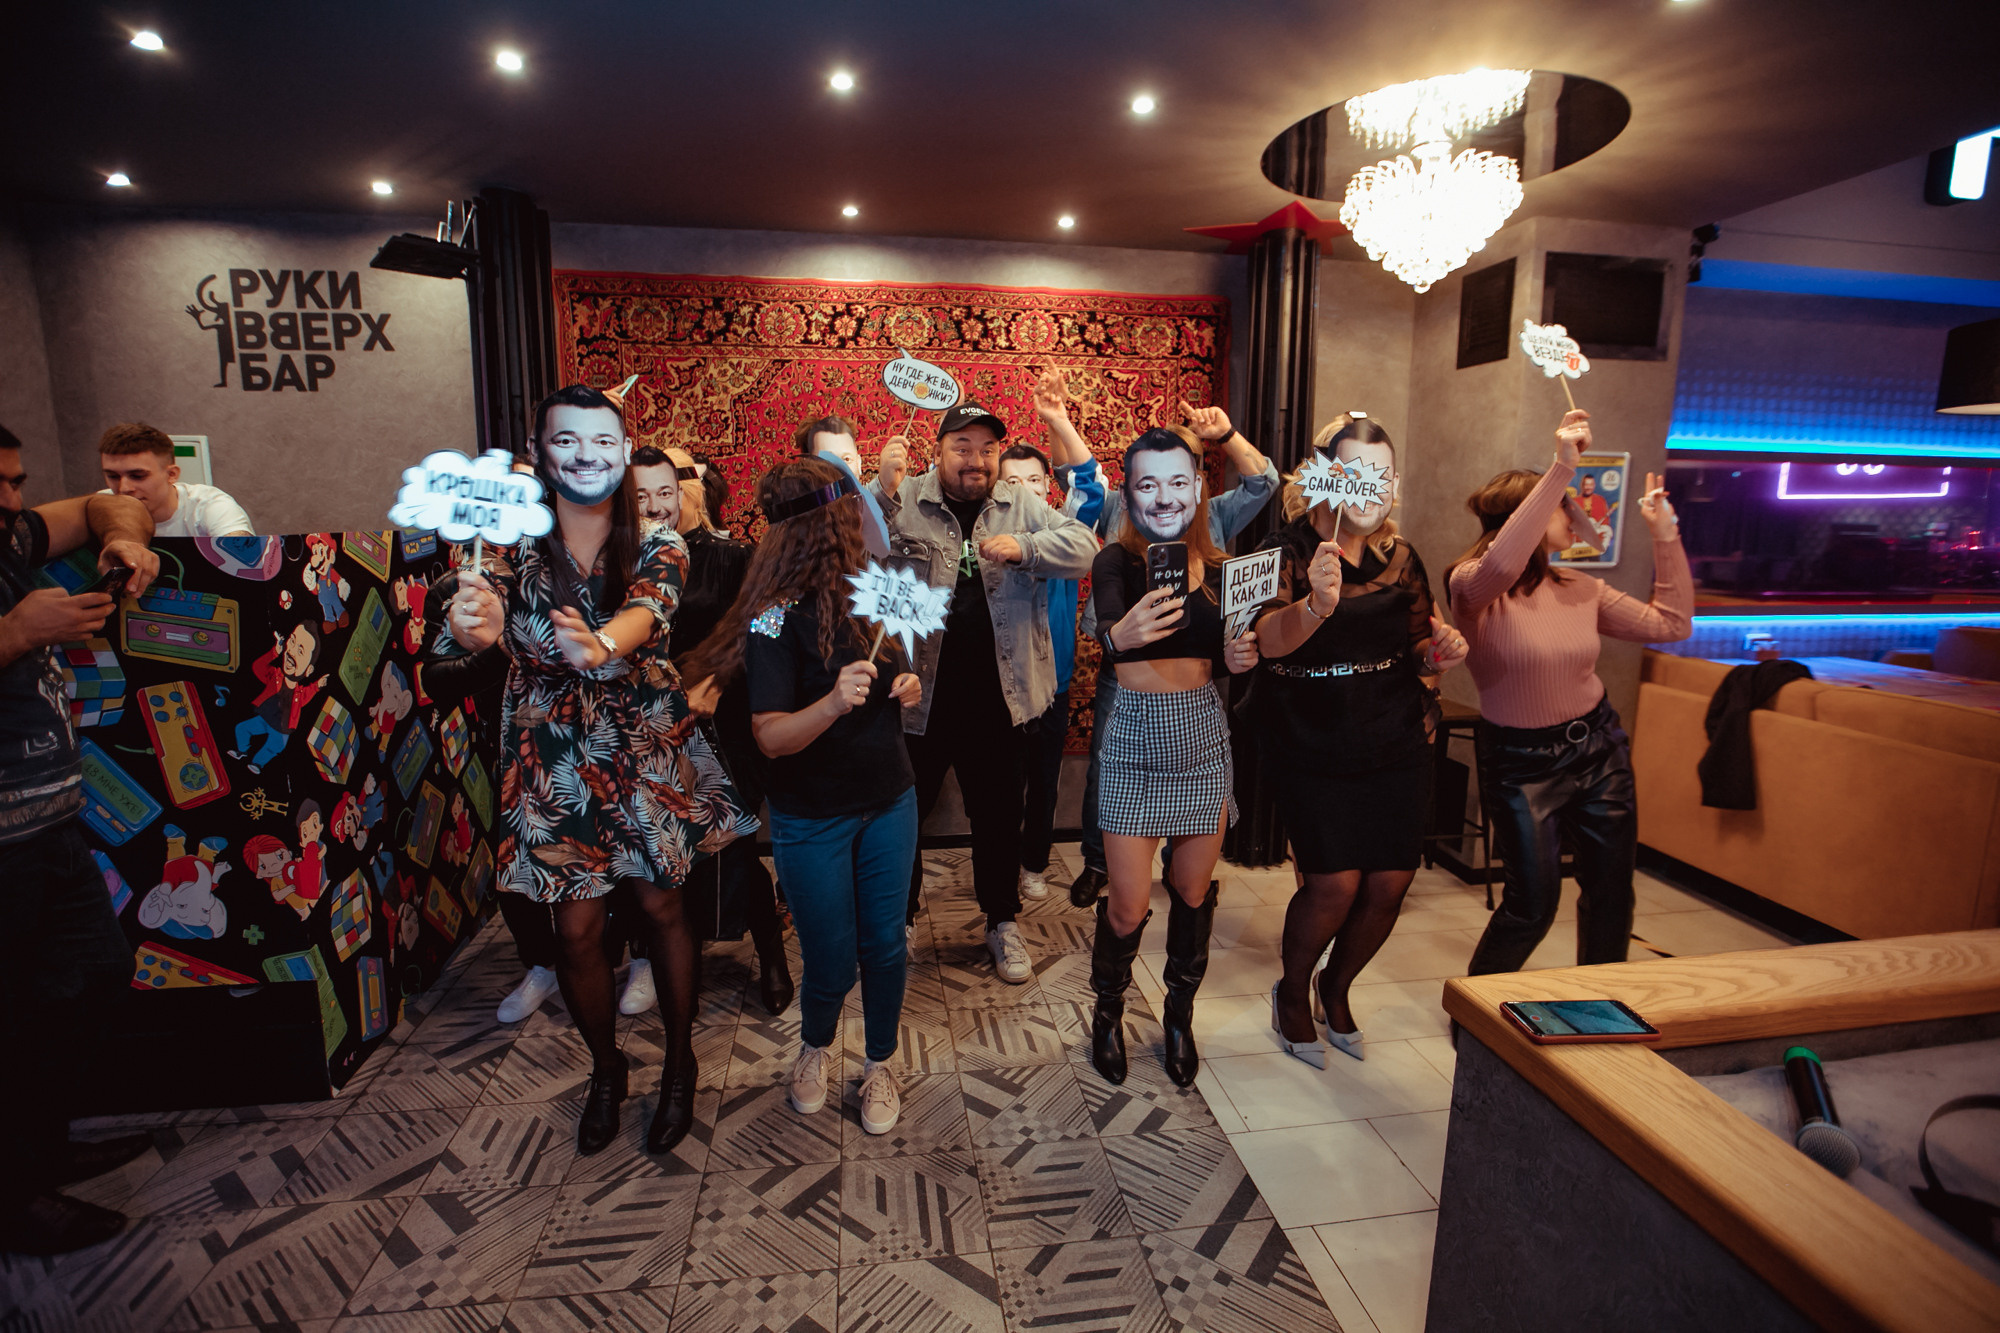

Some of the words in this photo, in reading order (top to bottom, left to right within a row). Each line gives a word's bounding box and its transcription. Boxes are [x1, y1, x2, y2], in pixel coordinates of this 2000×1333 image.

[229, 268, 362, 310] РУКИ
[234, 311, 395, 351] ВВЕРХ
[239, 353, 336, 392] БАР
[892, 361, 905, 374] НУ
[905, 366, 924, 380] ГДЕ
[924, 373, 939, 386] ЖЕ
[889, 375, 953, 405] ДЕВЧНКИ?
[425, 469, 528, 508] КРОШКА
[1308, 476, 1343, 493] GAME
[1345, 480, 1377, 497] OVER
[450, 502, 501, 530] МОЯ
[1154, 568, 1184, 580] HOW
[1230, 551, 1275, 590] ДЕЛАЙ
[898, 580, 915, 598] BE
[1232, 583, 1258, 607] КАК
[1261, 579, 1272, 598] Я!
